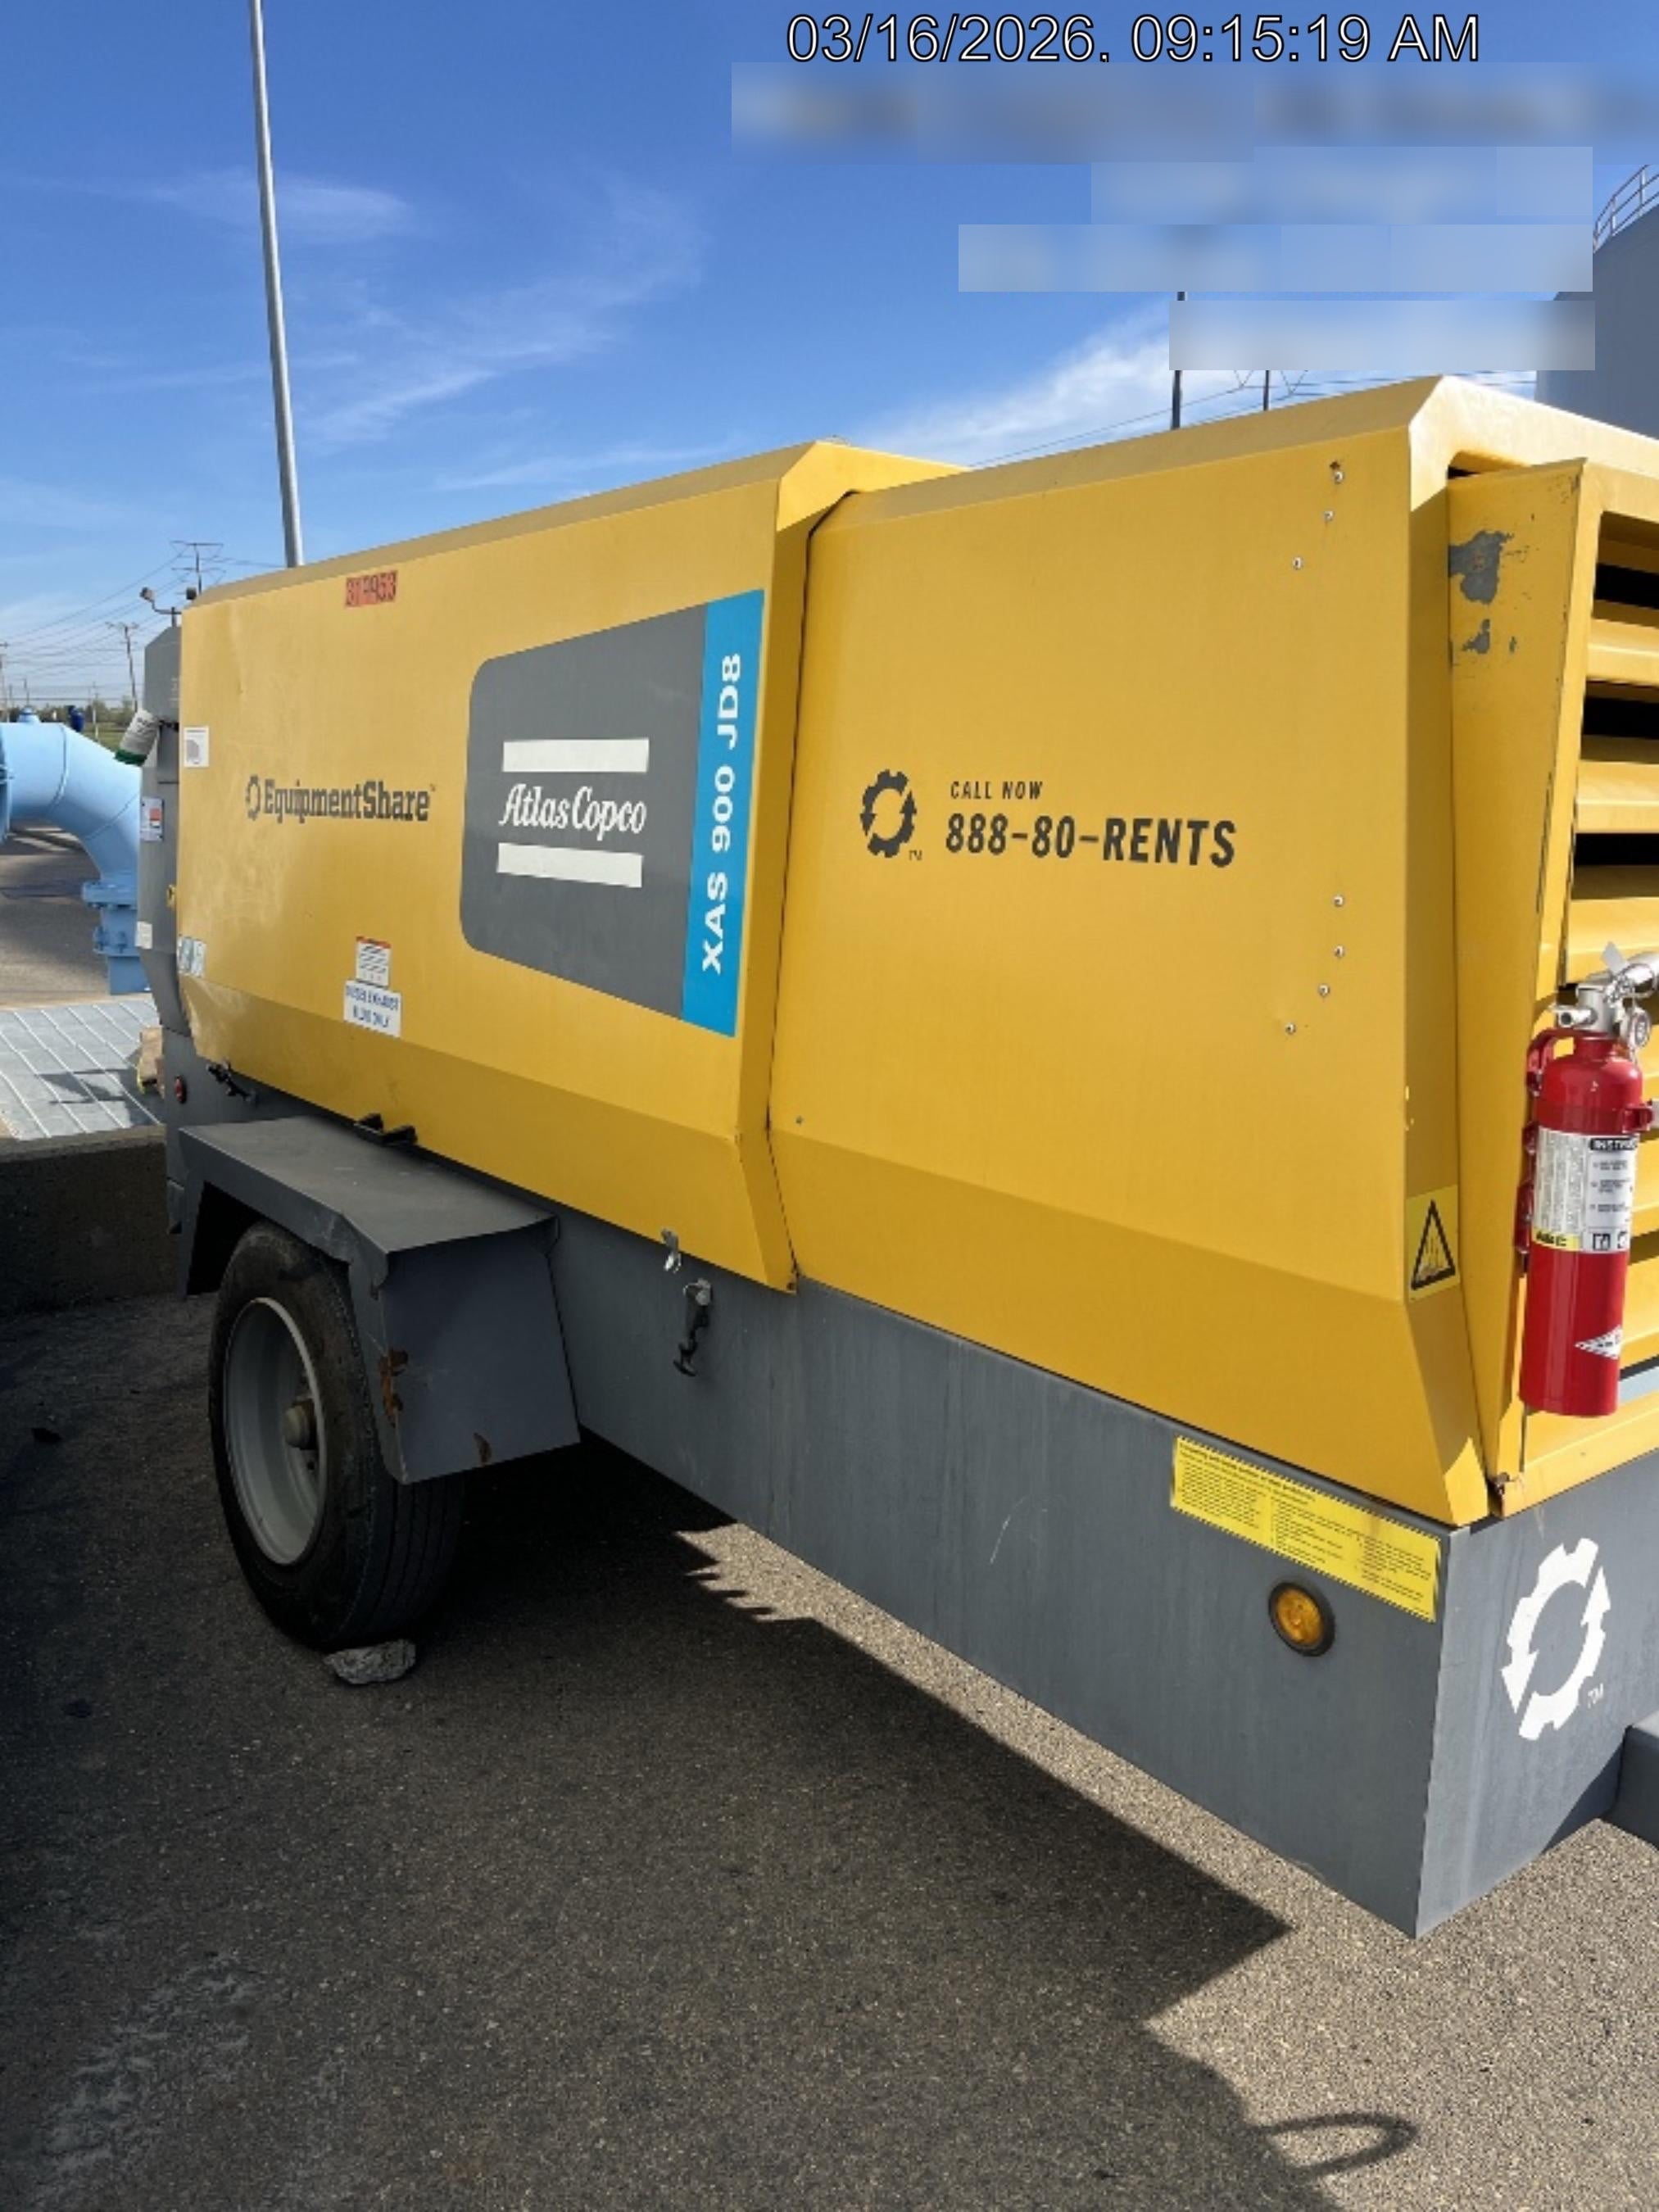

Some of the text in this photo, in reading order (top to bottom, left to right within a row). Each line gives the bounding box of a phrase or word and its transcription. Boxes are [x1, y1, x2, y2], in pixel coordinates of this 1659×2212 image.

[263, 779, 429, 823] EquipmentShare
[498, 783, 647, 841] Atlas Copco
[702, 653, 741, 975] XAS 900 JD8
[950, 781, 1044, 800] CALL NOW
[945, 813, 1236, 868] 888-80-RENTS
